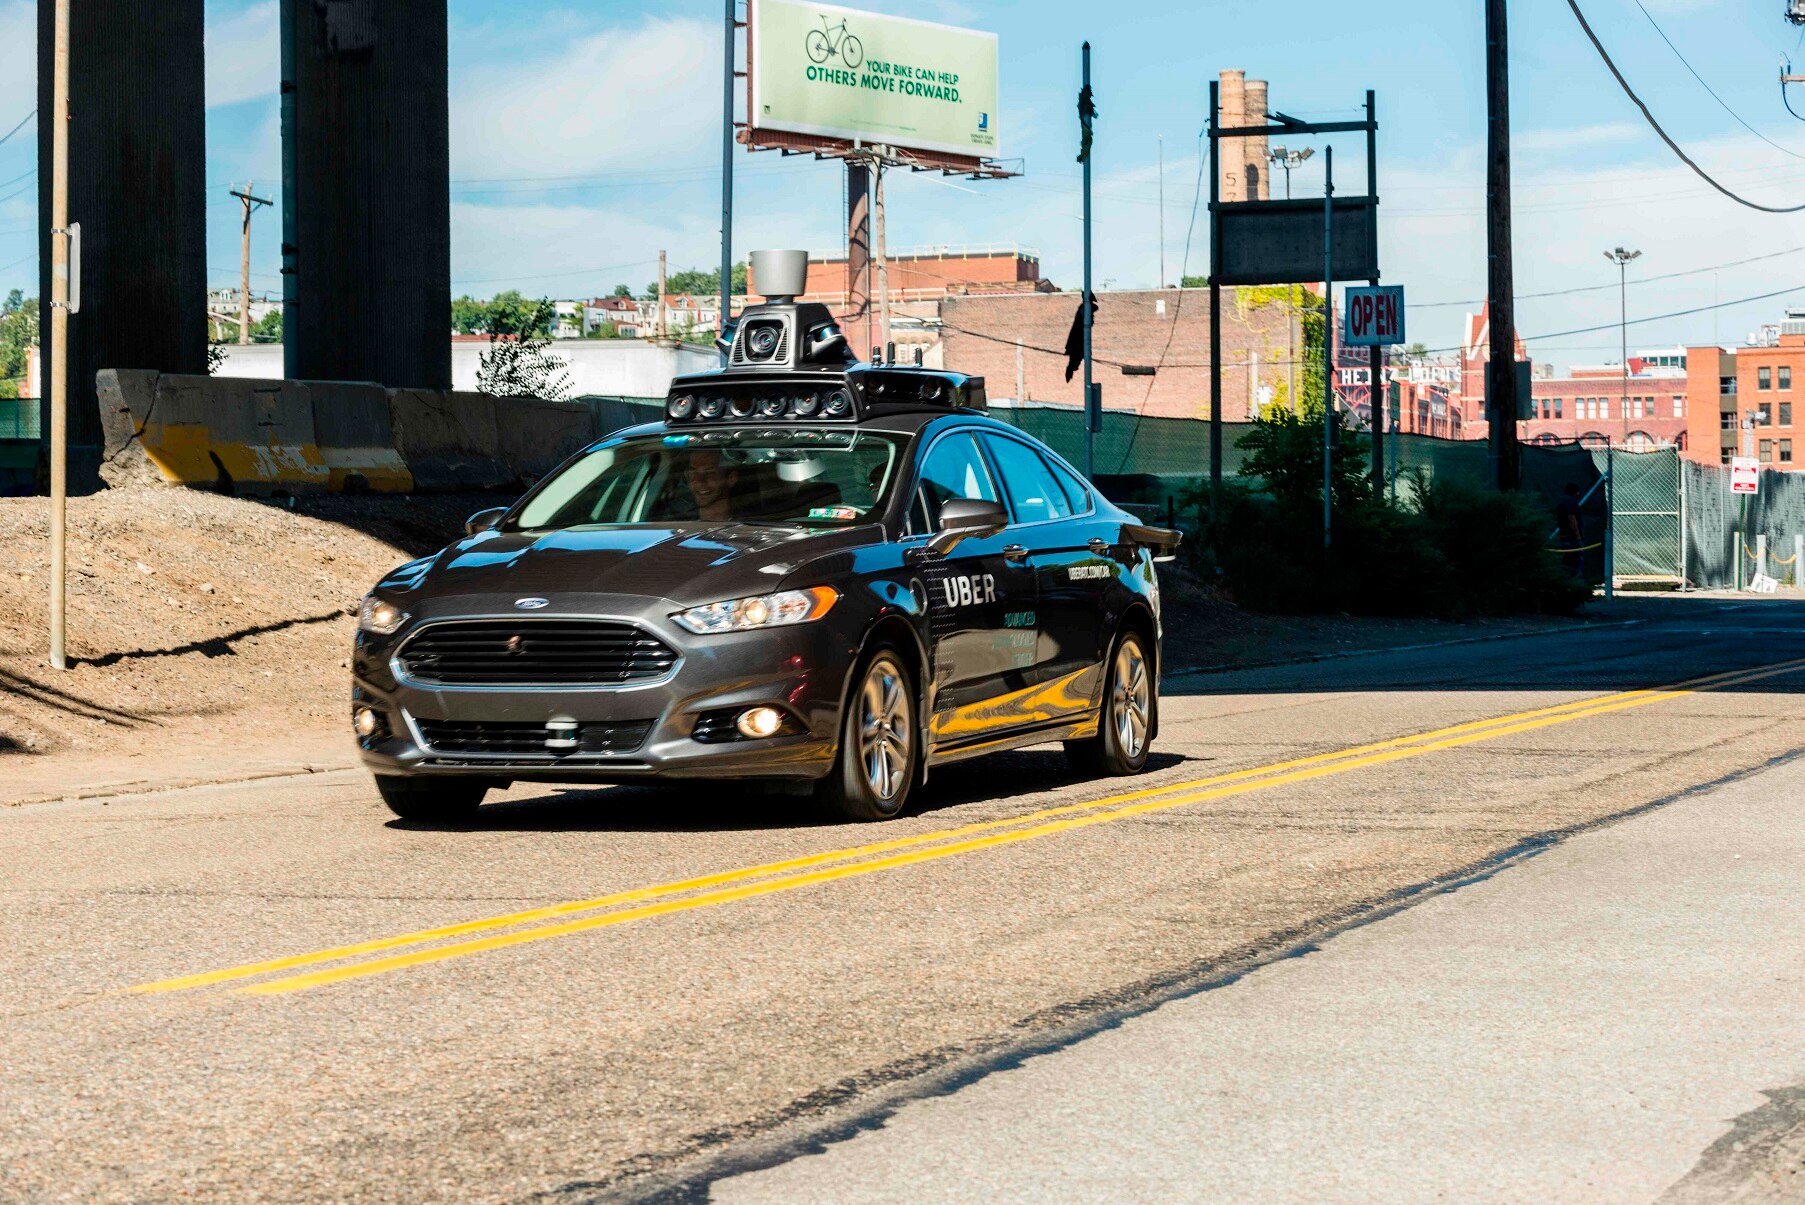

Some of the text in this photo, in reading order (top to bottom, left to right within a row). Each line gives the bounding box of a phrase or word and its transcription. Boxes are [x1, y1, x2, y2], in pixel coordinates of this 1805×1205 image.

[806, 65, 962, 103] OTHERS MOVE FORWARD.
[867, 60, 959, 85] YOUR BIKE CAN HELP
[1351, 294, 1397, 336] OPEN
[942, 573, 996, 608] UBER
